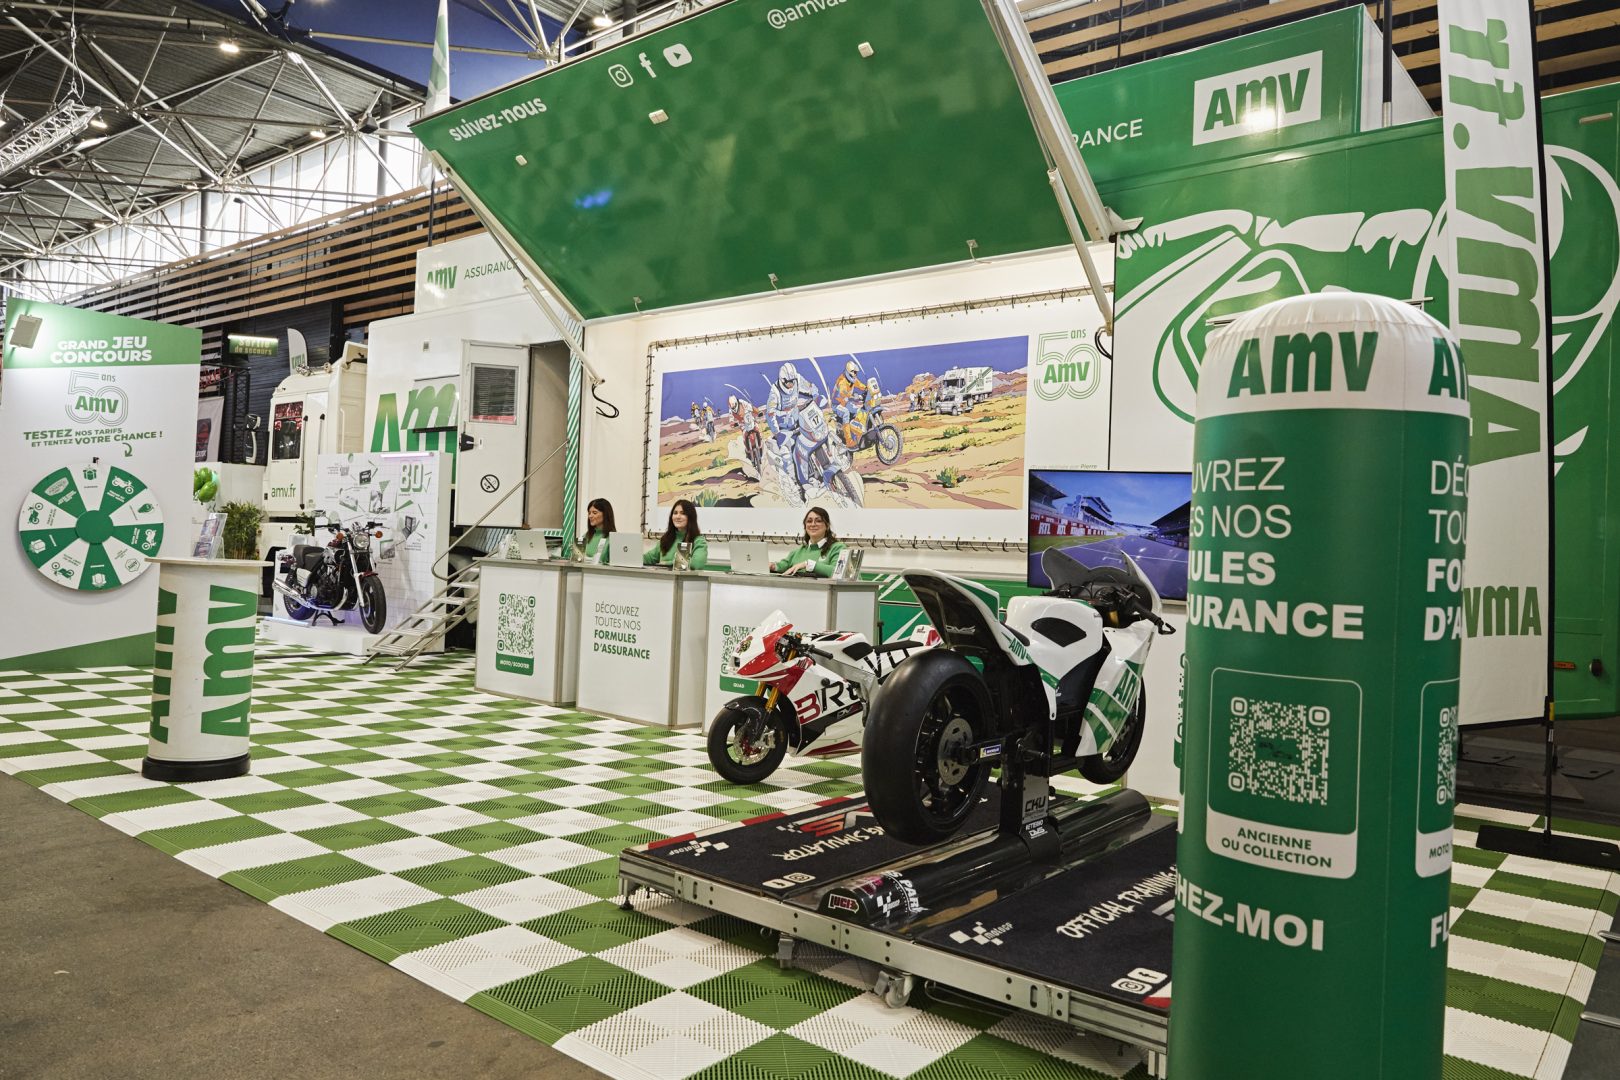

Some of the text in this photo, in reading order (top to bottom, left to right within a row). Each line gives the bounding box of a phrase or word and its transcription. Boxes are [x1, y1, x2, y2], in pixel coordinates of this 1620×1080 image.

[449, 97, 547, 142] suivez-nous
[1070, 328, 1087, 339] ans
[57, 336, 148, 351] GRAND JEU
[51, 350, 152, 364] CONCOURS
[101, 374, 116, 383] ans
[23, 429, 72, 440] TESTEZ
[75, 435, 111, 445] VOTRE
[114, 432, 157, 441] CHANCE
[271, 483, 296, 498] amv.fr
[1211, 505, 1292, 539] NOS
[1187, 551, 1276, 586] ULES
[595, 601, 640, 617] DÉCOUVREZ
[595, 616, 642, 631] TOUTES NOS
[594, 629, 637, 644] FORMULES
[593, 642, 650, 660] D'ASSURANCE
[1238, 827, 1312, 850] ANCIENNE
[1221, 837, 1332, 868] OU COLLECTION
[1175, 867, 1324, 951] HEZ-MOI
[1056, 900, 1135, 939] OFFICIAL
